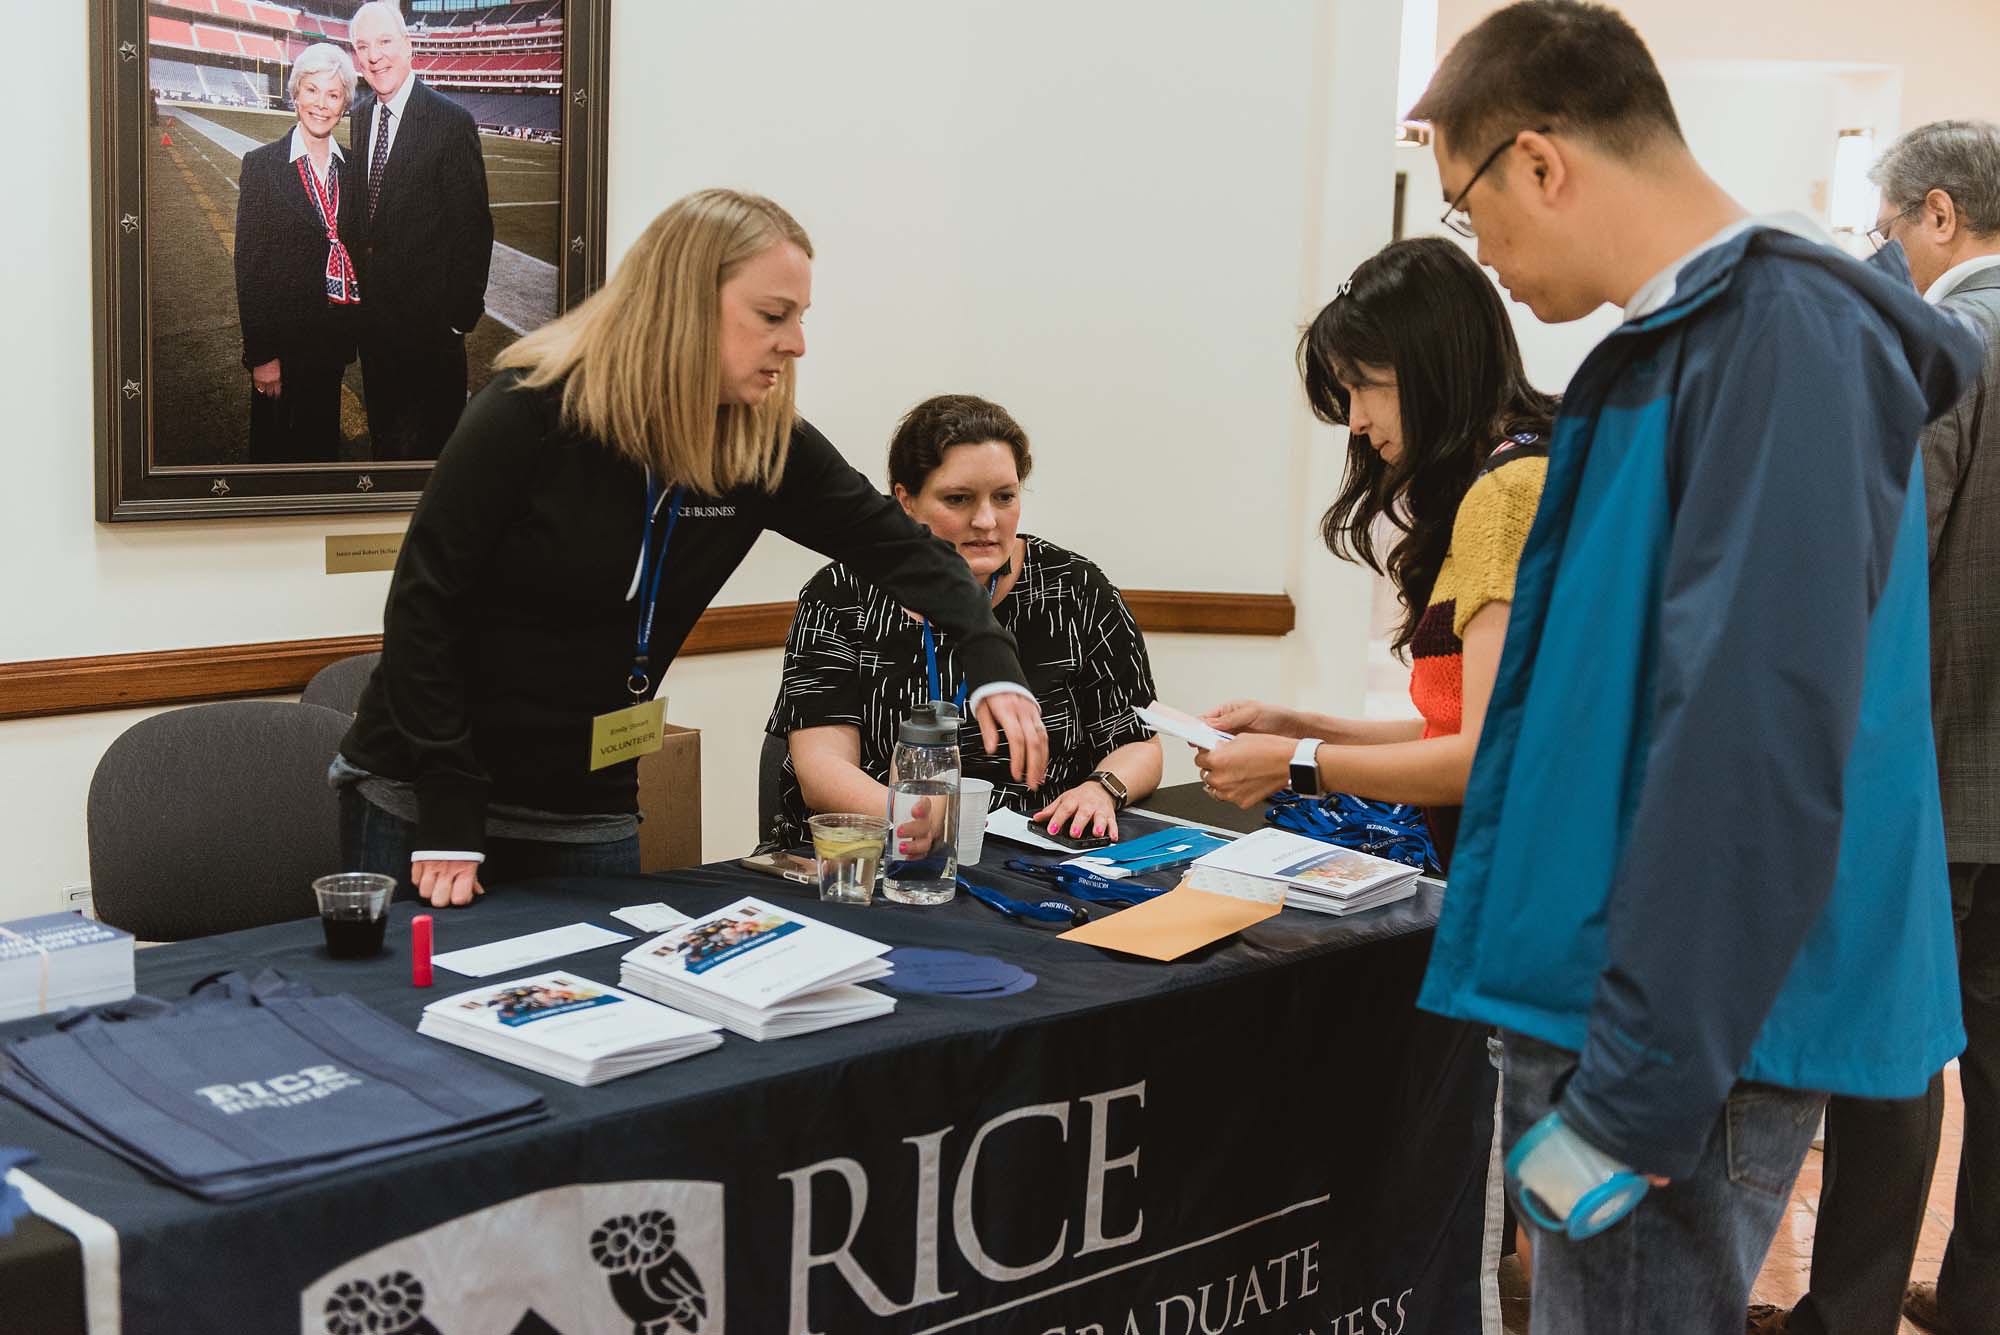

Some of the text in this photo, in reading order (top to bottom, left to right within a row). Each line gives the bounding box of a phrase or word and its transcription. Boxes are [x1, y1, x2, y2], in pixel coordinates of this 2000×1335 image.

[600, 732, 656, 755] VOLUNTEER
[194, 1065, 349, 1106] RICE
[777, 1079, 1146, 1335] RICE
